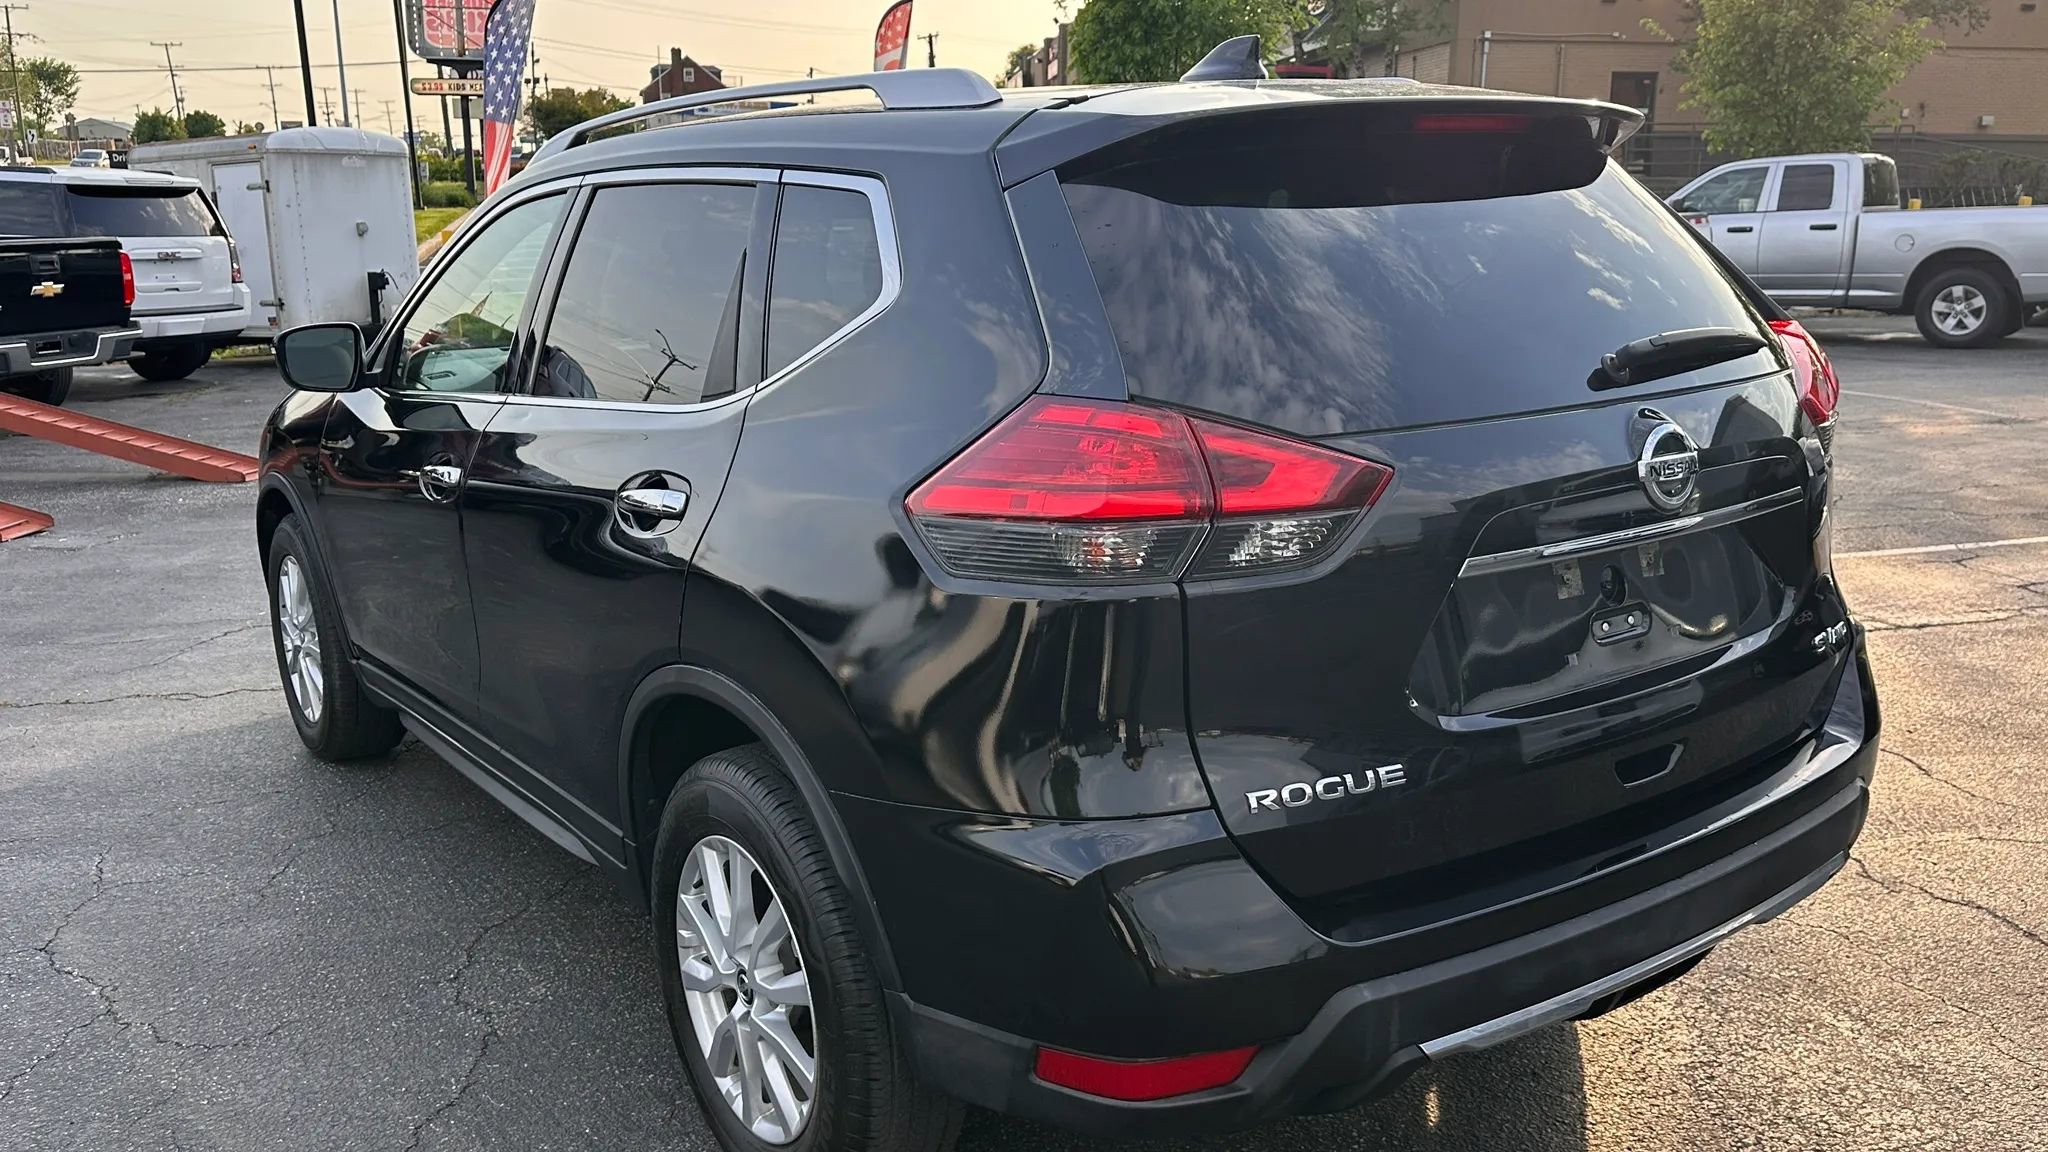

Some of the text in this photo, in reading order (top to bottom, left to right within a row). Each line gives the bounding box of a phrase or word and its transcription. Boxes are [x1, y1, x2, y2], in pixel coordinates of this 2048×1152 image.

[447, 82, 466, 91] KIDS
[157, 251, 181, 260] GMC
[1649, 458, 1697, 478] NISSAN
[1245, 763, 1407, 814] ROGUE
